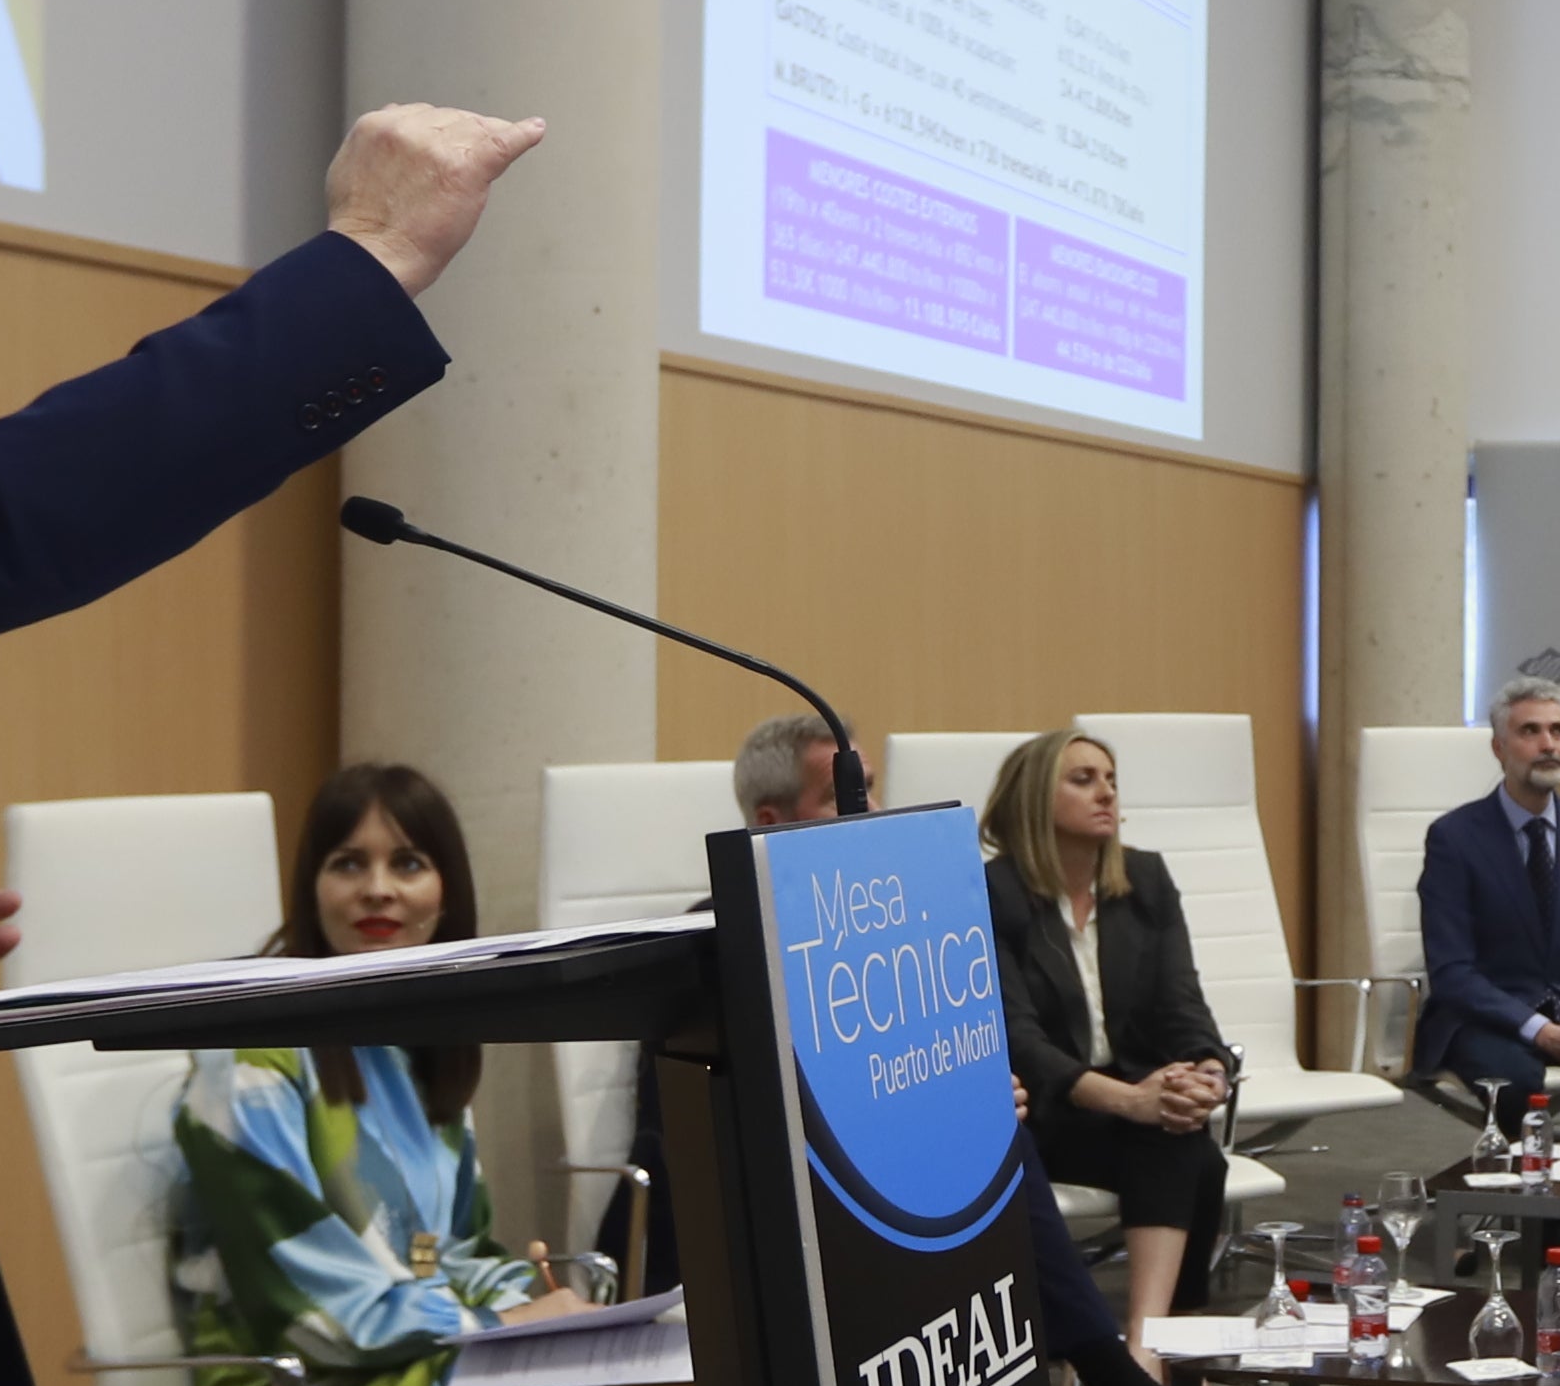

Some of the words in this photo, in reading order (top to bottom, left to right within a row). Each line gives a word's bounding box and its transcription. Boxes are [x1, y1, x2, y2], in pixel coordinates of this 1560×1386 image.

[811, 868, 906, 940] Mesa
[787, 910, 993, 1053] Técnica
[869, 1043, 930, 1100] Puerto
[931, 1028, 953, 1076] de
[953, 1009, 1000, 1068] Motril
